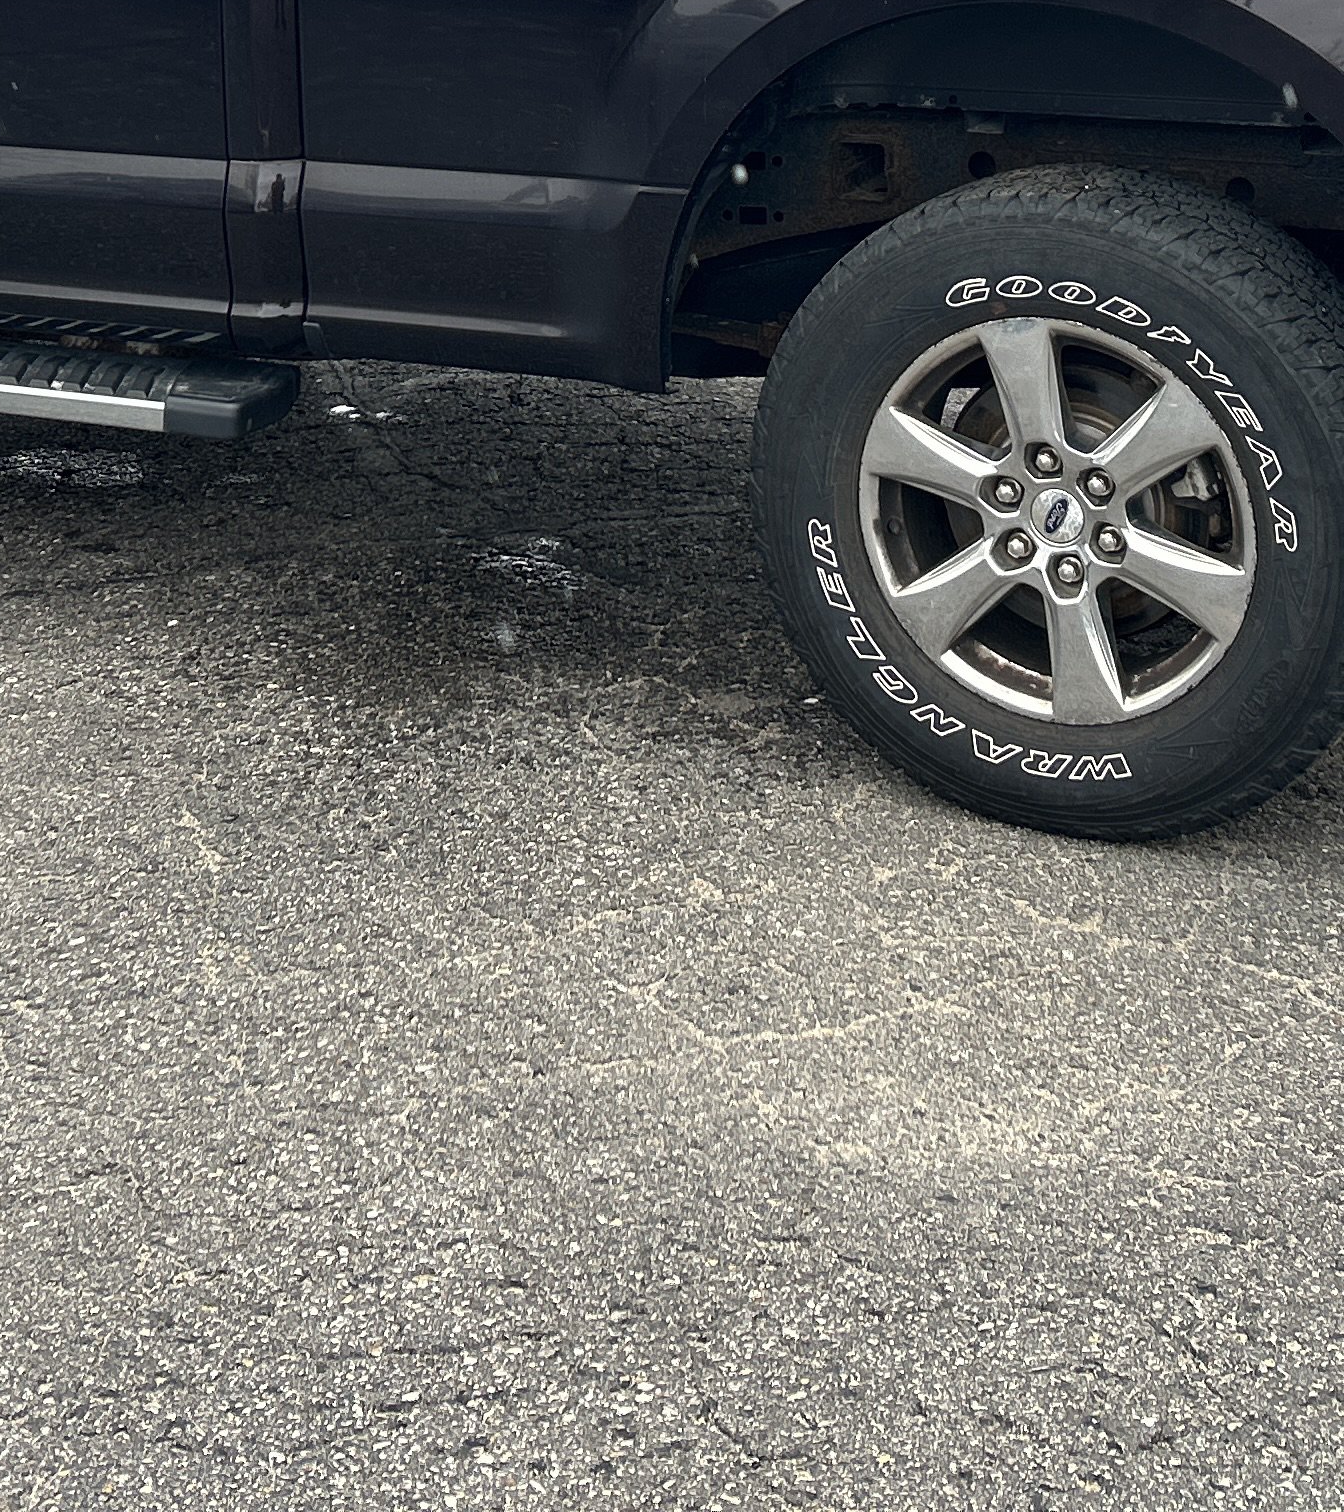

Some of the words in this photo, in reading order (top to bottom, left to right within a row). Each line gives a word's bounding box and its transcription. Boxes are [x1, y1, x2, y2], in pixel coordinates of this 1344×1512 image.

[945, 274, 1298, 553] GOODYEAR
[1046, 500, 1067, 531] Ford
[807, 518, 1133, 781] WRANGLER
